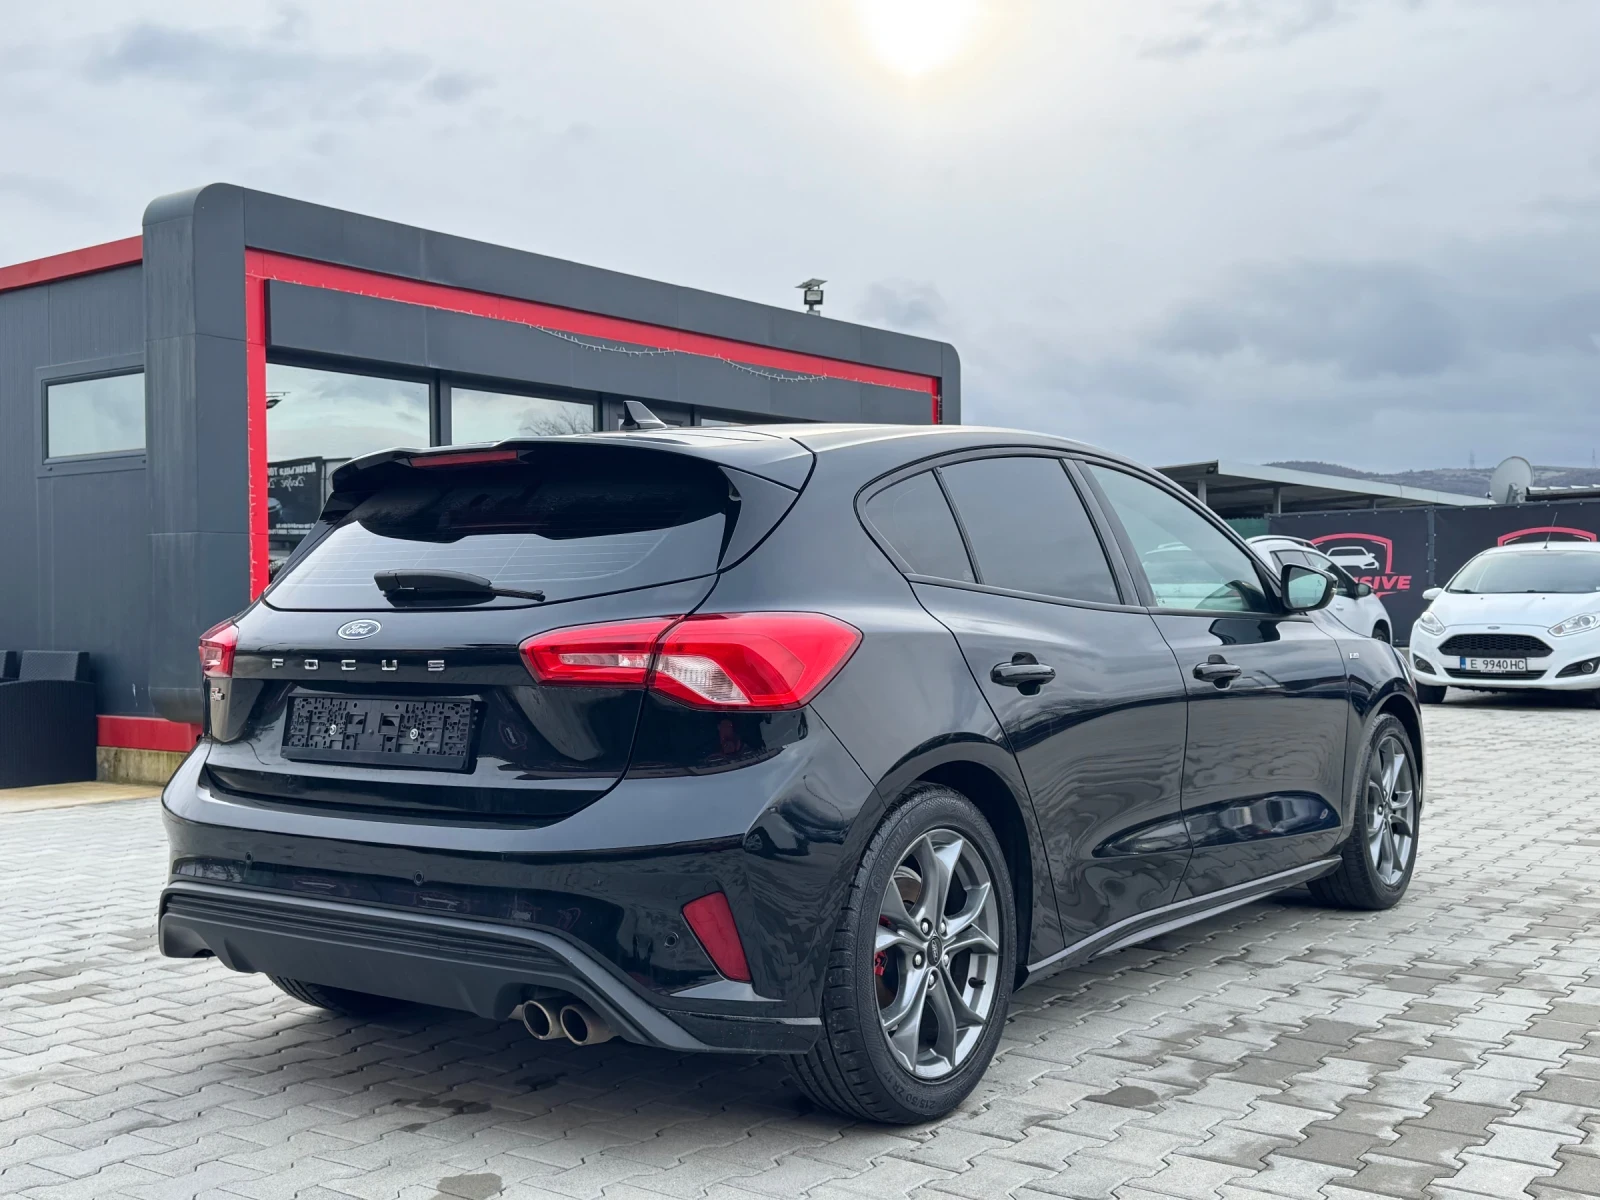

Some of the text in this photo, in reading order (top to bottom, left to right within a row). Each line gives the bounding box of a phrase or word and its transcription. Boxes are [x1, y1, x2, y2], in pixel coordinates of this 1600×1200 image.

[271, 658, 445, 672] FOCUS
[1470, 659, 1525, 670] E 9940 HC
